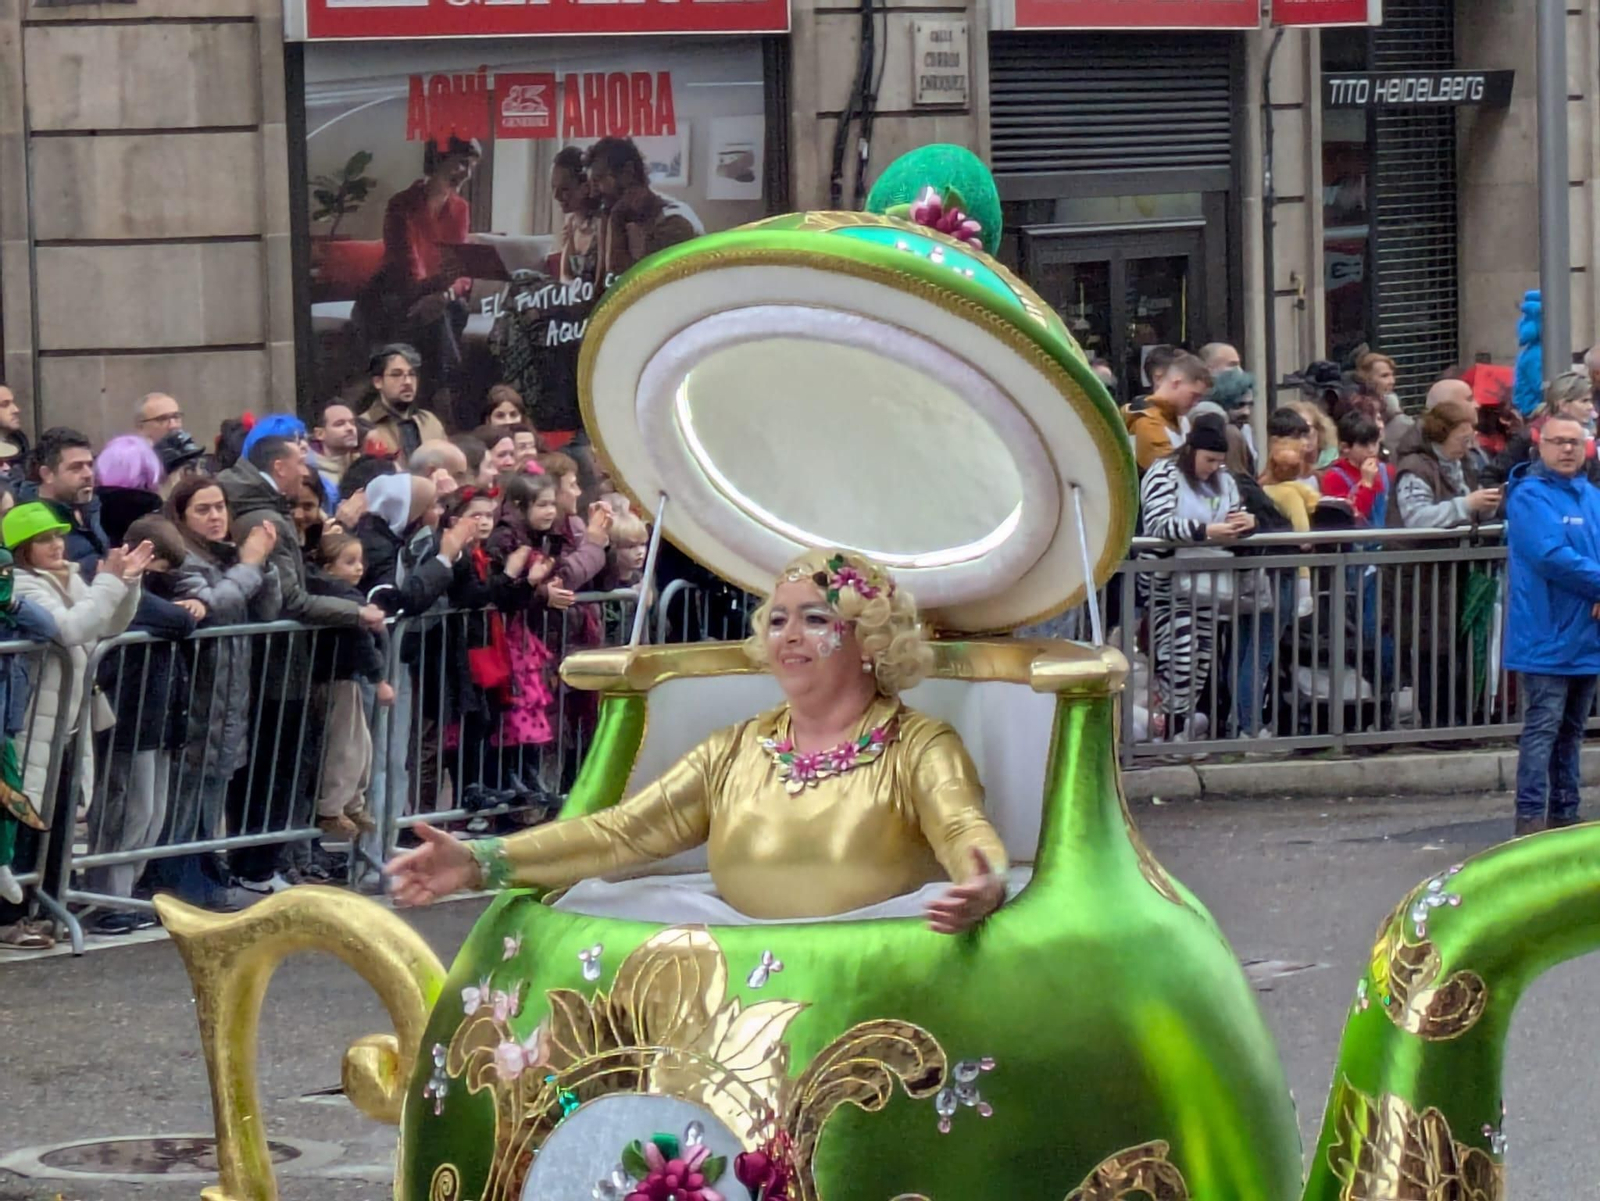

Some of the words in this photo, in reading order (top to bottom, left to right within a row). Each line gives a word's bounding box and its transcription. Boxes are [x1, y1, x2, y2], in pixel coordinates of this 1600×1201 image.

[562, 71, 677, 138] AHORA
[1329, 79, 1370, 105] TITO
[480, 292, 506, 319] EL
[514, 276, 593, 313] FUTURO
[546, 318, 588, 347] AQU
